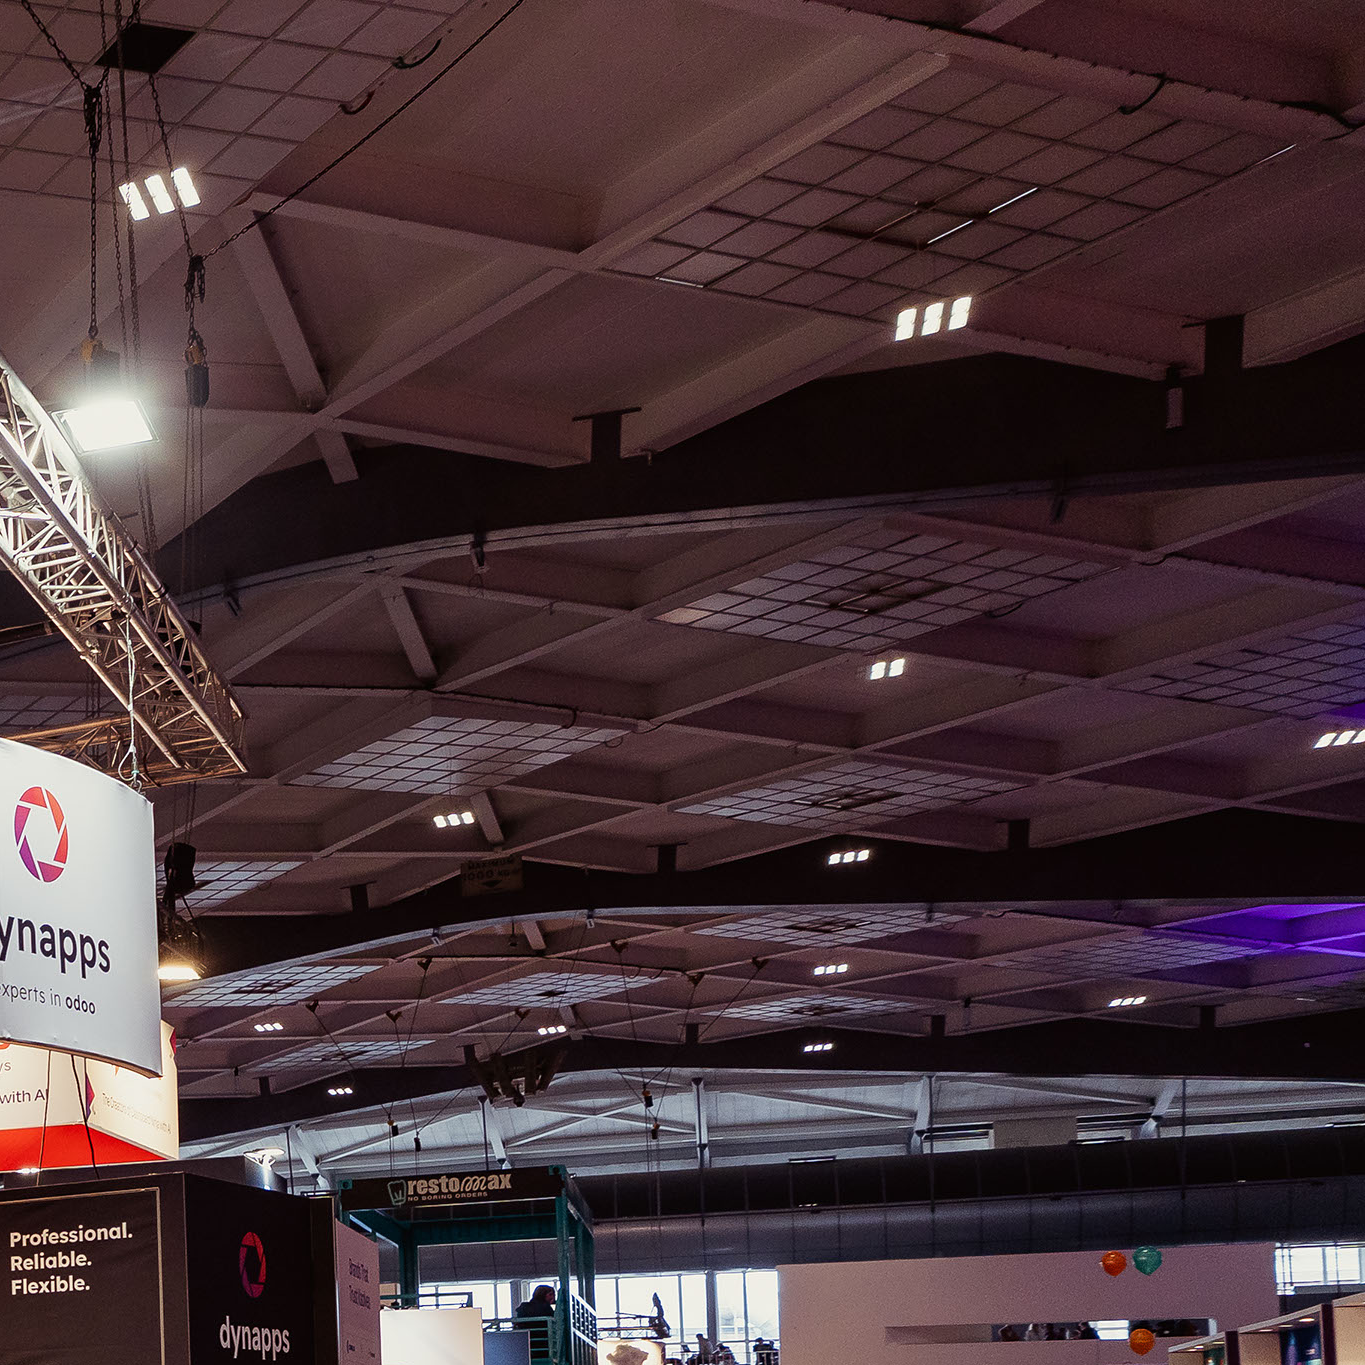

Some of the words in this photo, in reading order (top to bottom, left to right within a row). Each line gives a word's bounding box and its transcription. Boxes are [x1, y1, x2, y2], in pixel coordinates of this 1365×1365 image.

[50, 988, 62, 1007] in
[65, 994, 96, 1015] odoo
[0, 1089, 31, 1105] with
[407, 1173, 512, 1196] restomax
[421, 1193, 453, 1201] BORING
[455, 1191, 488, 1199] ORDERS
[9, 1221, 134, 1248] Professional.
[10, 1250, 93, 1272] Reliable.
[11, 1274, 91, 1296] Flexible.
[219, 1315, 291, 1361] dynapps
